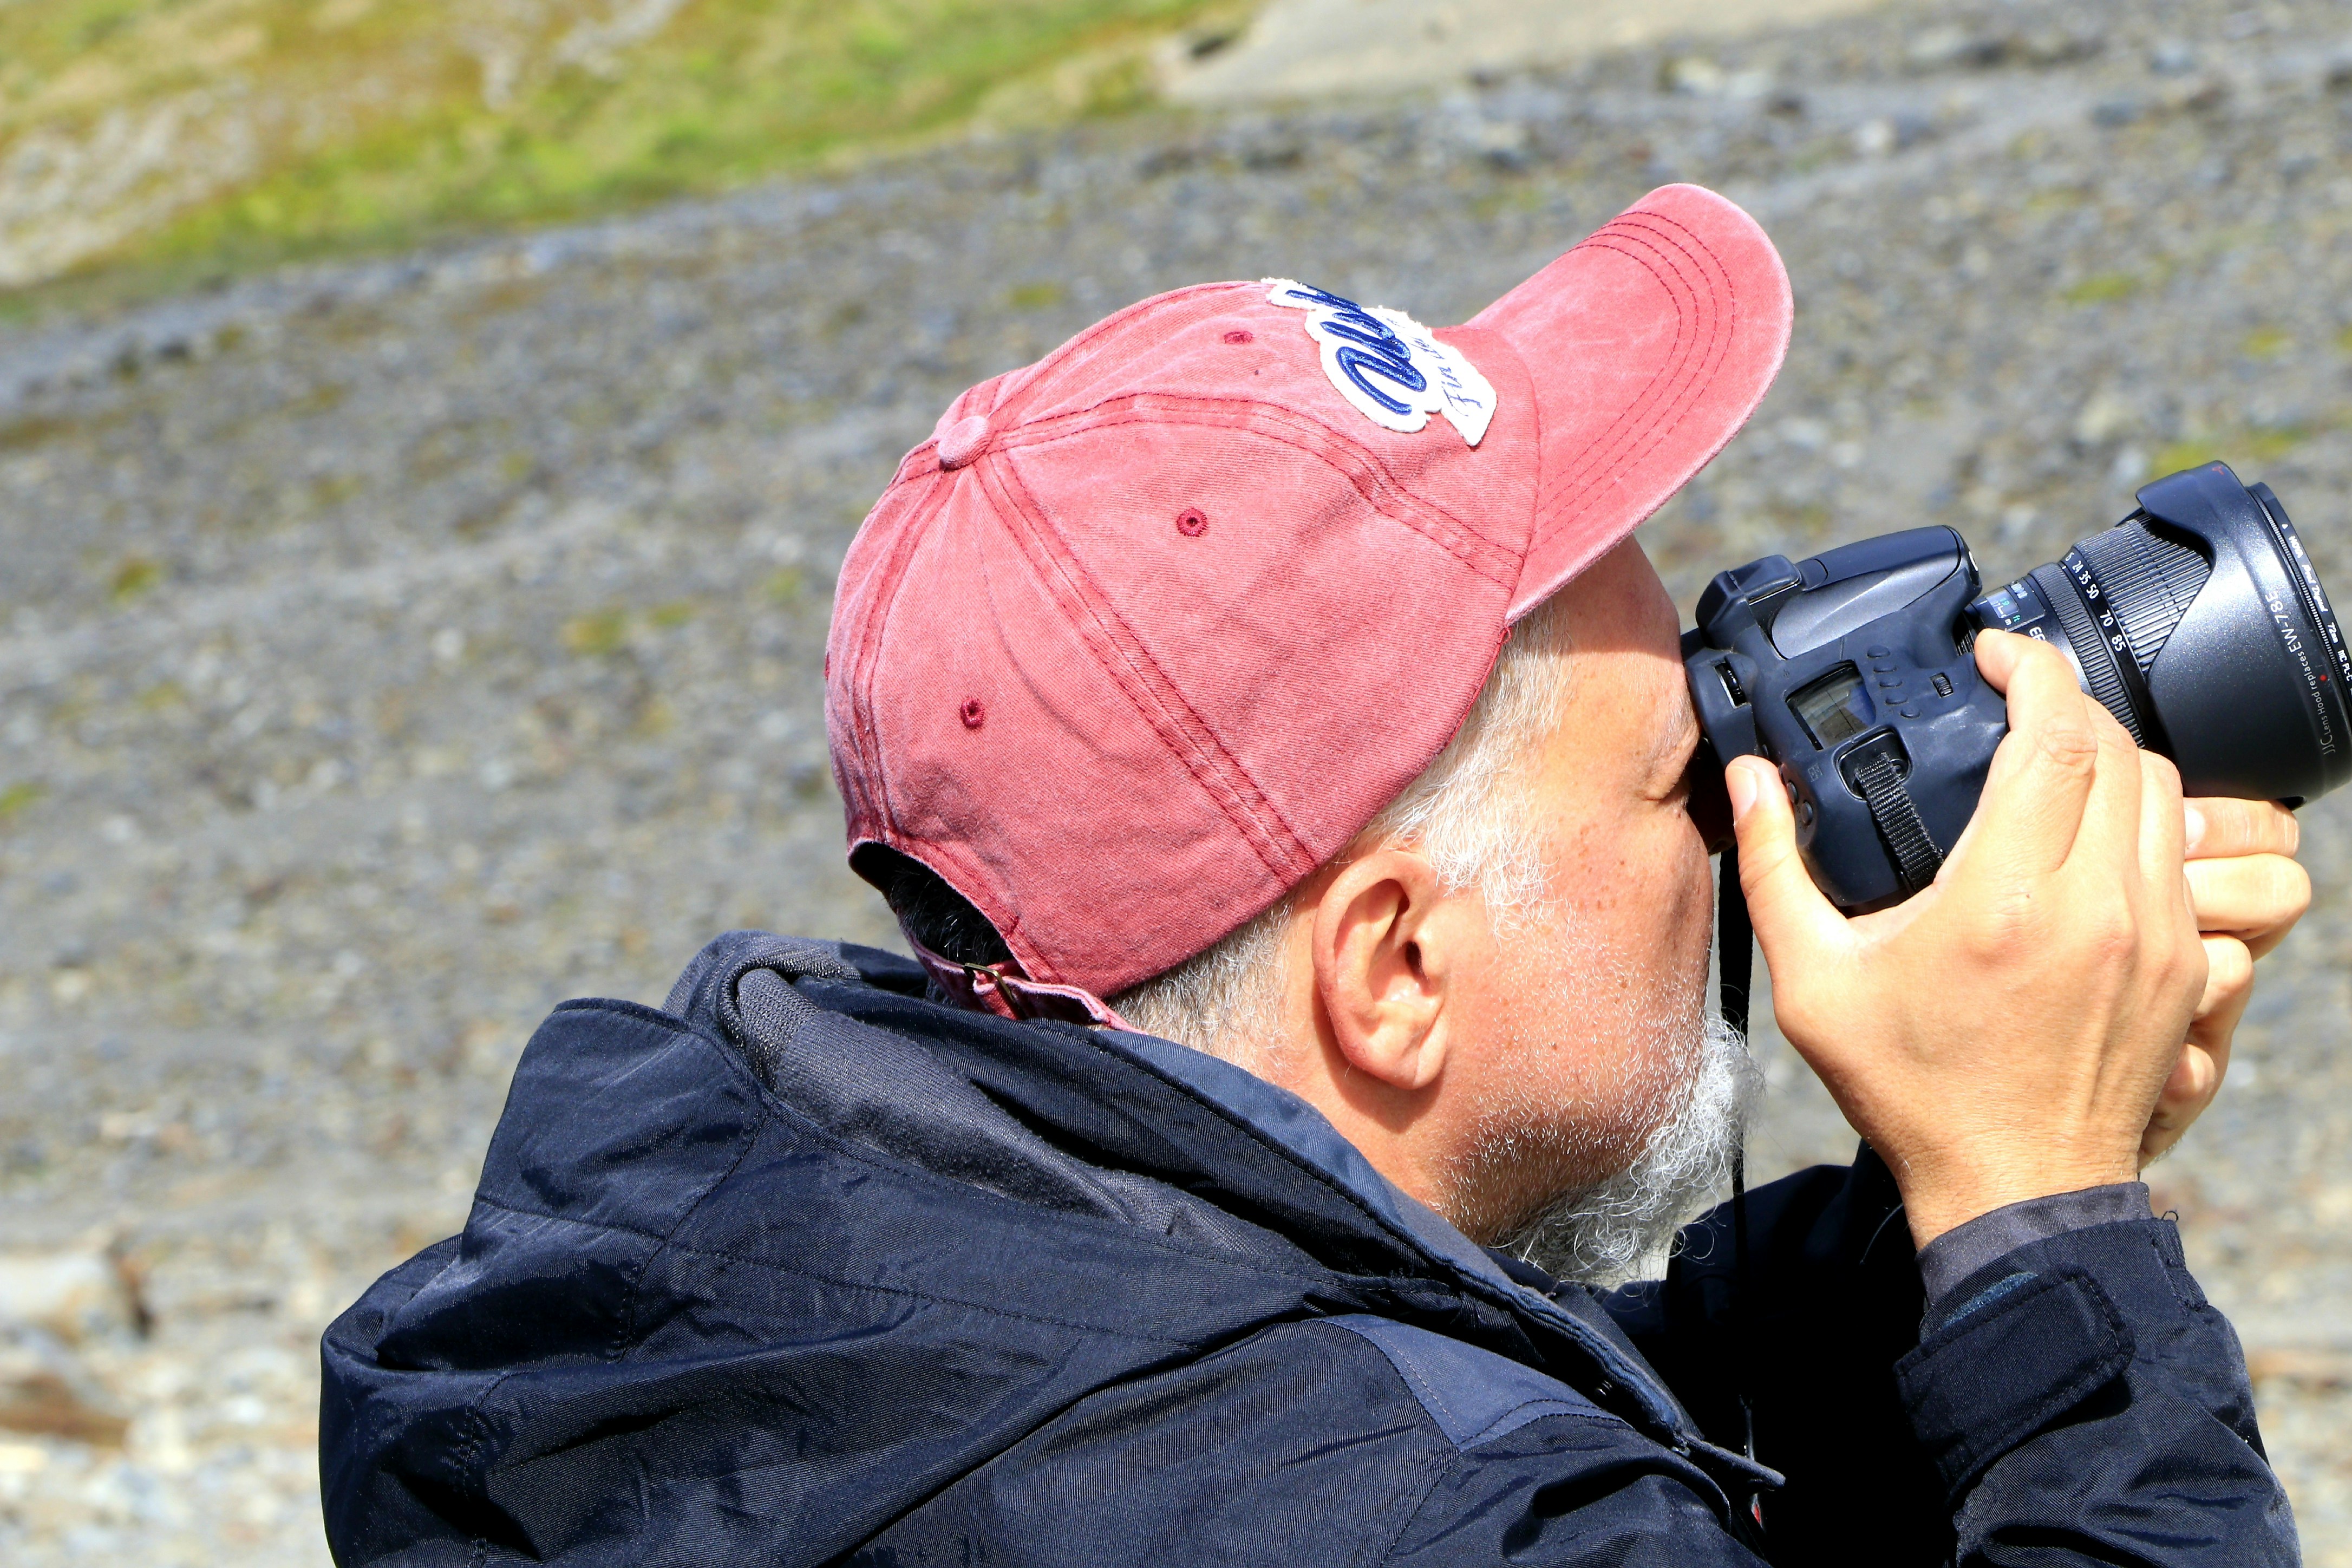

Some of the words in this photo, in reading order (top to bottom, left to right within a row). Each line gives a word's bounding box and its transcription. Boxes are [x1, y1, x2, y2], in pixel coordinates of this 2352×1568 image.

[1438, 367, 1482, 416] Fin
[2072, 560, 2083, 573] 24
[2079, 570, 2092, 585] 35
[2086, 584, 2099, 599] 50
[2100, 609, 2114, 627] 70
[2112, 634, 2126, 651] 85
[2289, 535, 2304, 559] HOYA
[2328, 622, 2338, 643] 72mm
[2265, 591, 2302, 653] EW-78E
[2297, 651, 2317, 690] replaces
[2311, 691, 2326, 715] Hood
[2321, 715, 2331, 735] Lens
[2320, 734, 2335, 755] JJC
